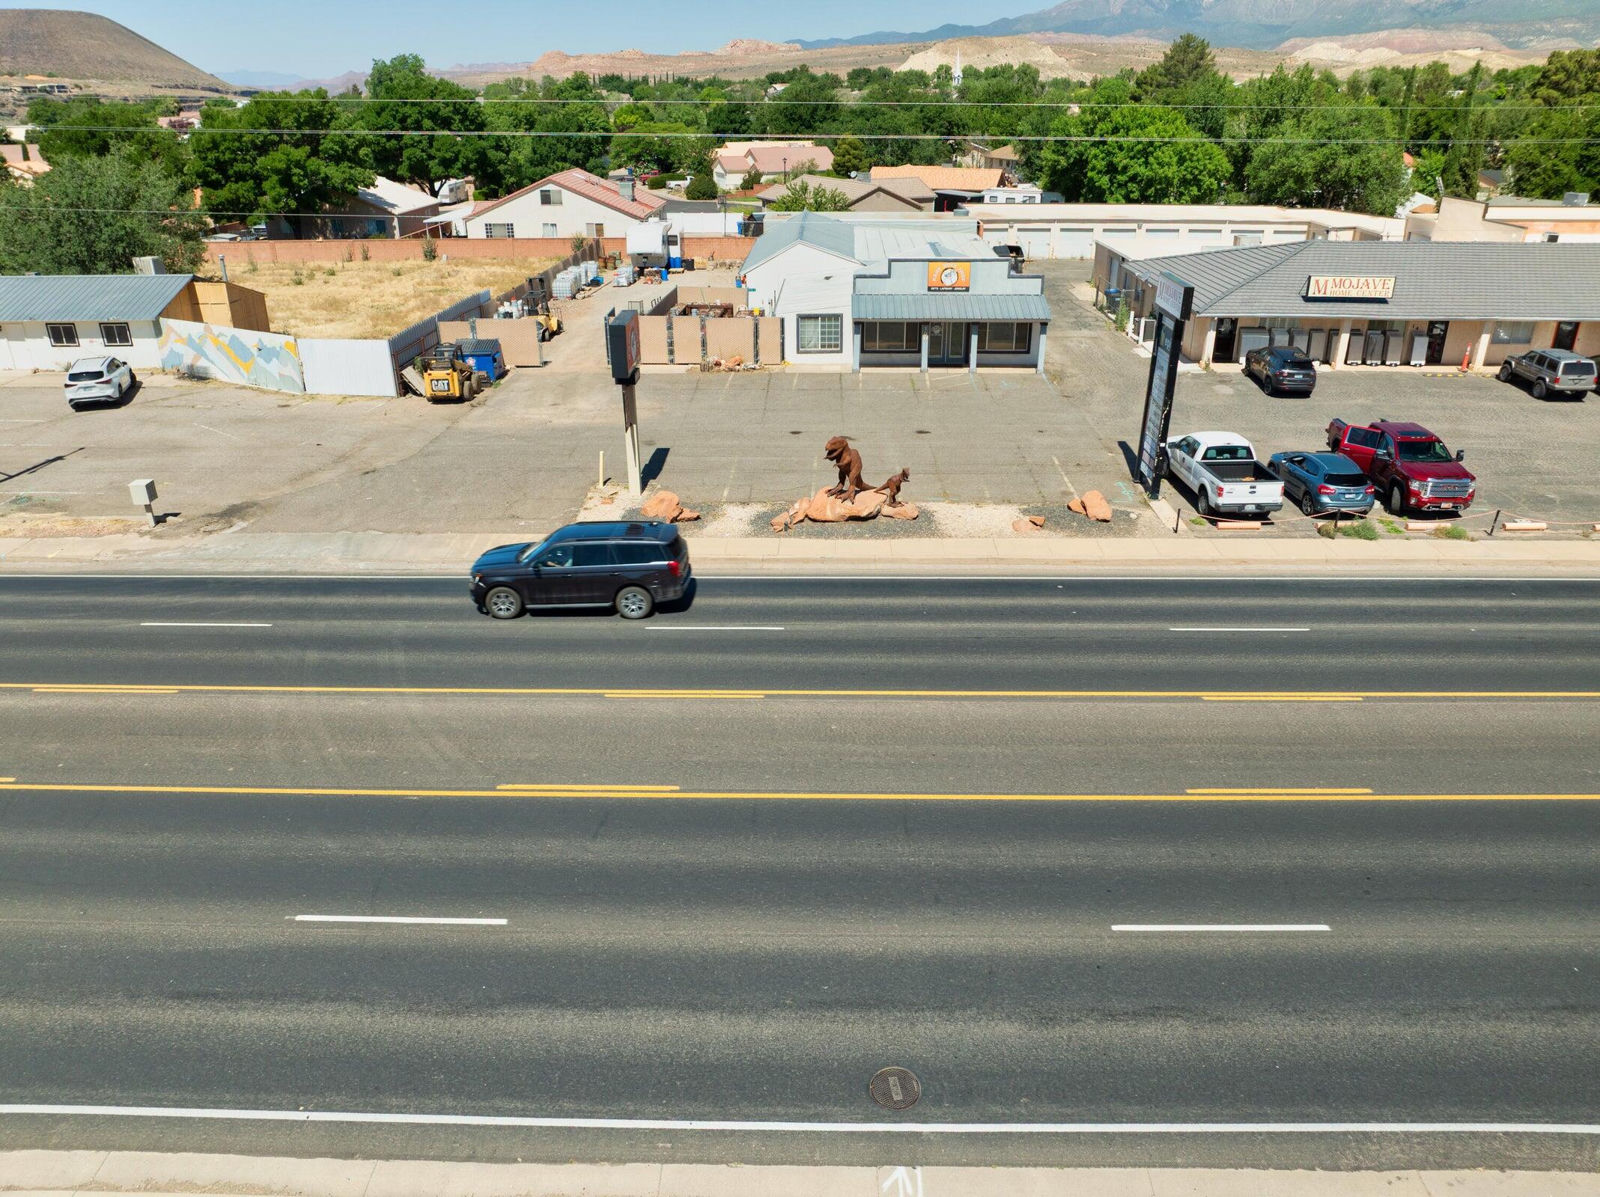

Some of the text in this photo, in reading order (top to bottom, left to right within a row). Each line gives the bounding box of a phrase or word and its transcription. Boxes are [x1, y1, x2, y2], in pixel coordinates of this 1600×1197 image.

[1313, 278, 1391, 295] M MOJAVE
[1356, 289, 1390, 297] CENTER
[431, 380, 449, 391] CAT
